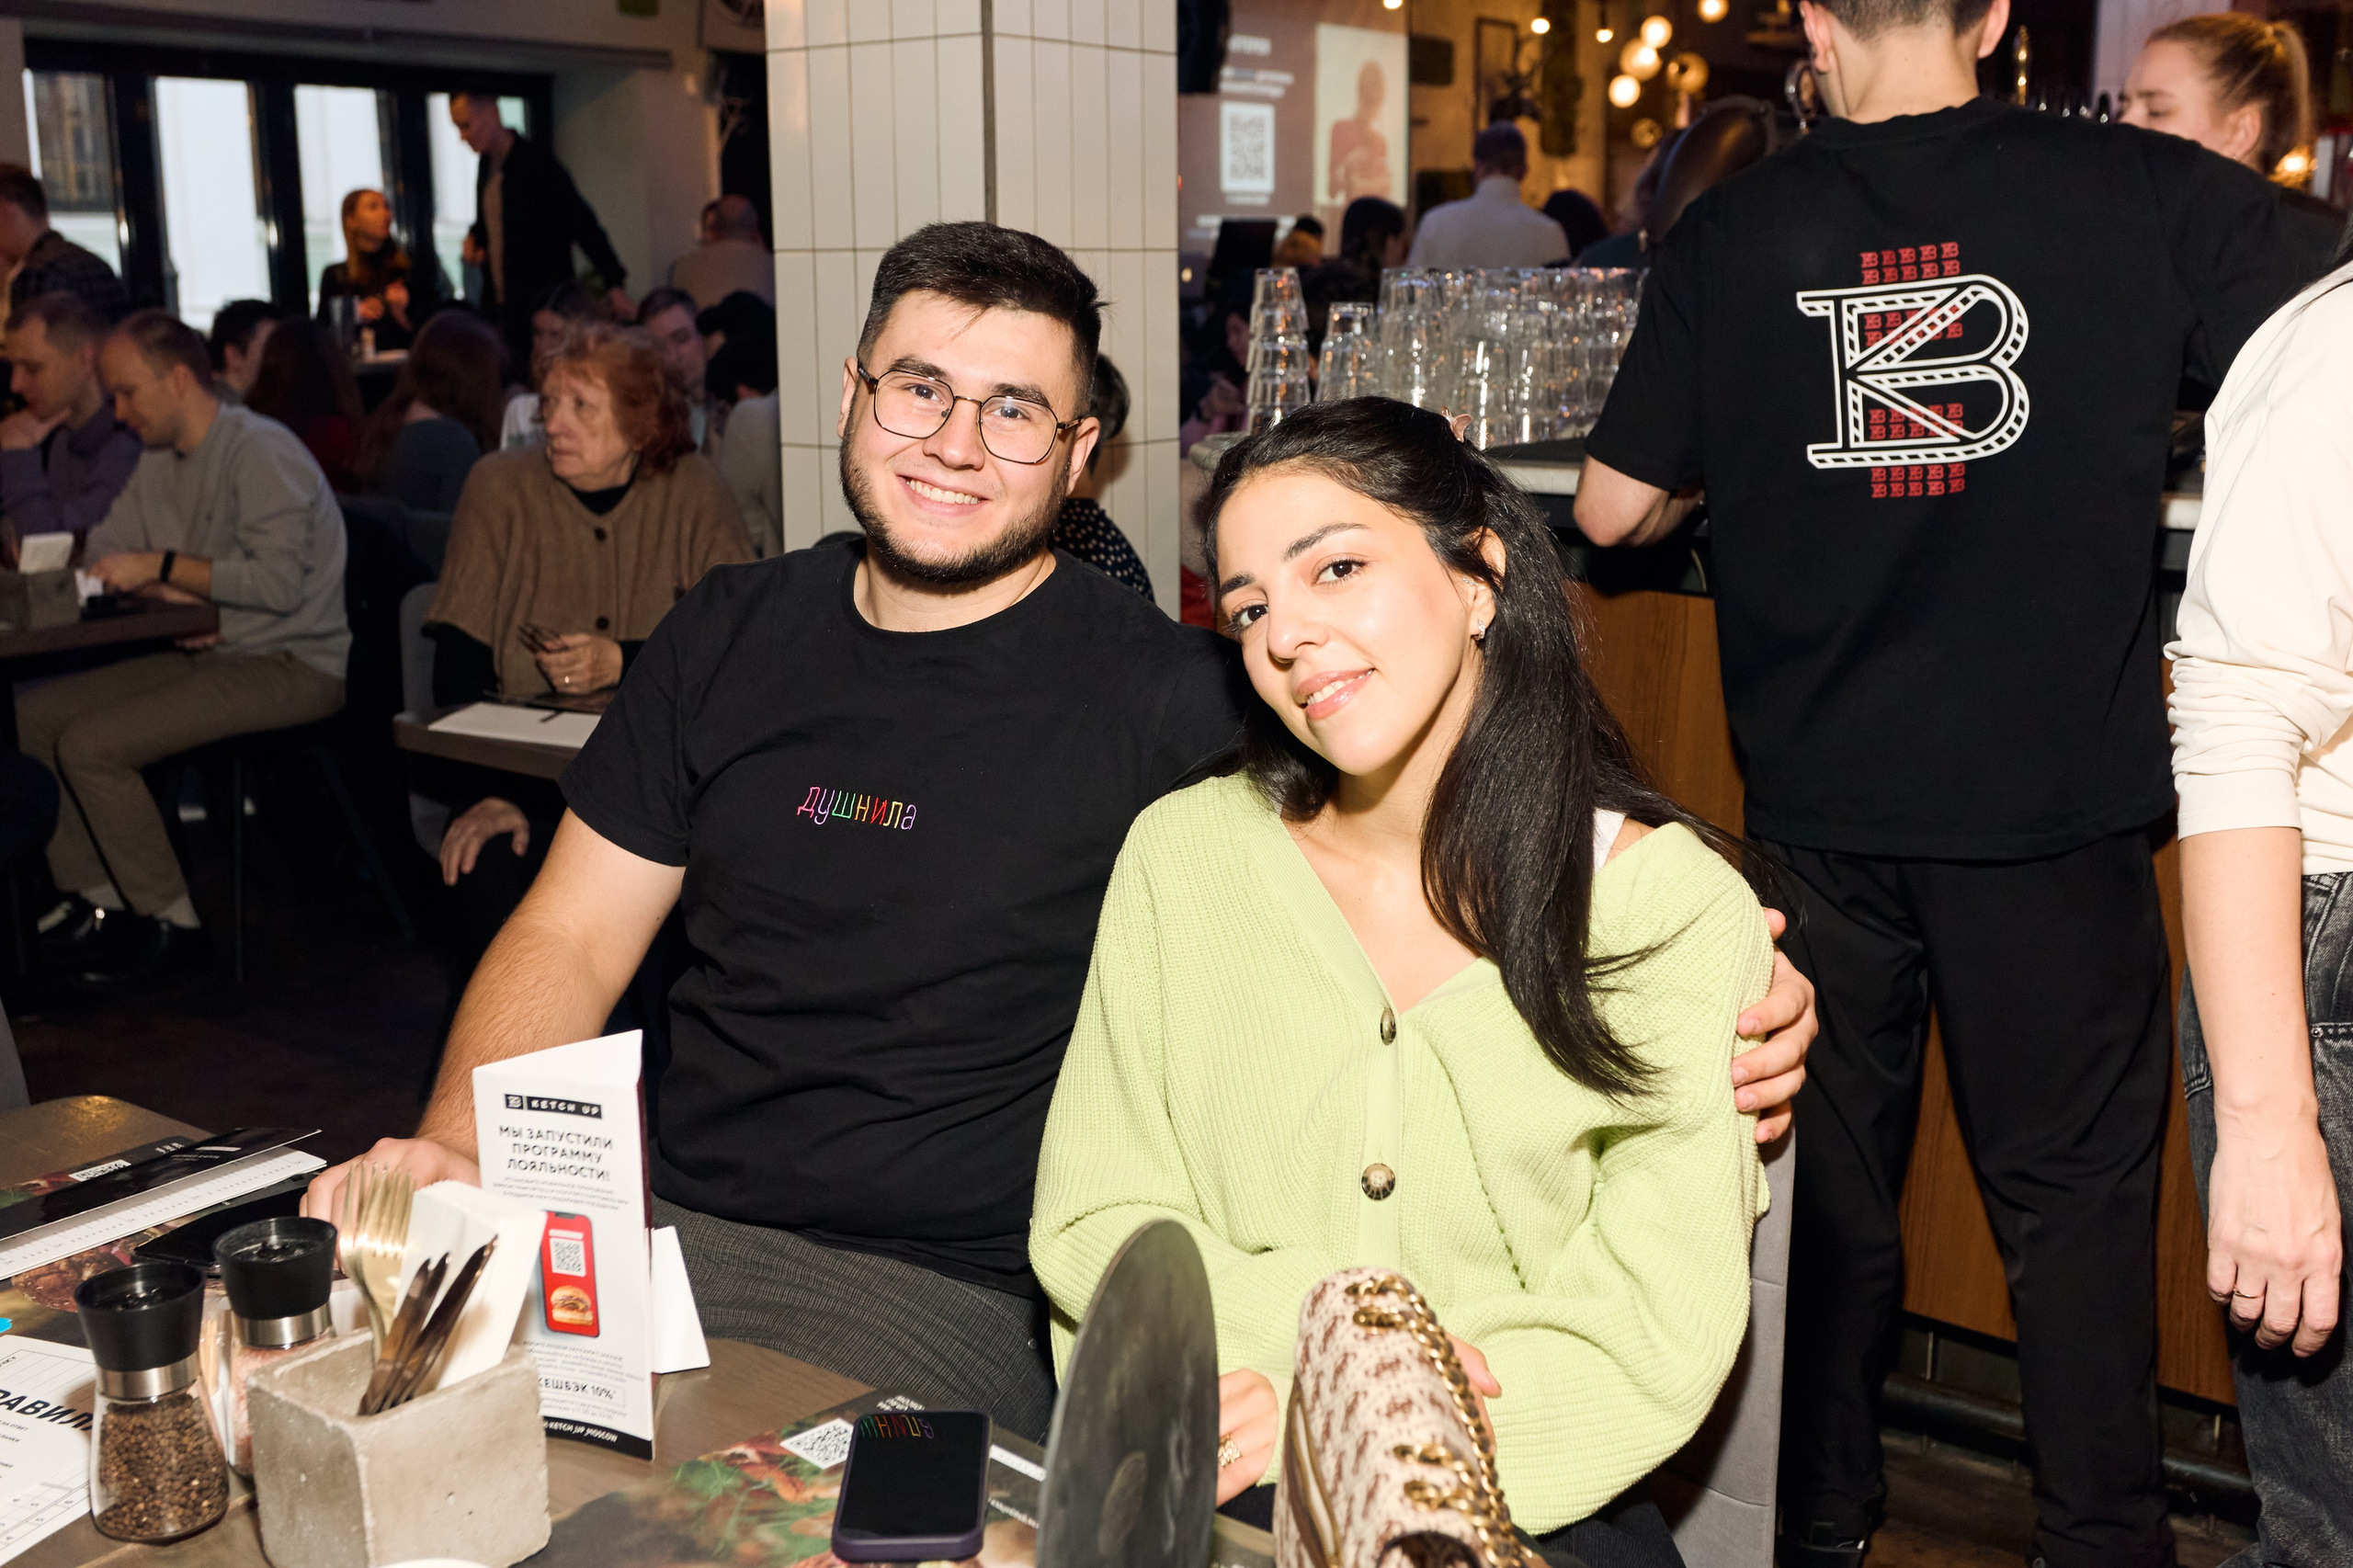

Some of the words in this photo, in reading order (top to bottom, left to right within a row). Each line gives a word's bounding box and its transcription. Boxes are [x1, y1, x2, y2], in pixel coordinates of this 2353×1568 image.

[797, 787, 916, 830] душнила
[531, 1100, 576, 1112] KETCH
[582, 1106, 599, 1115] UP
[499, 1126, 523, 1138] МЫ
[527, 1128, 613, 1150] ЗАПУСТИЛИ
[513, 1143, 602, 1164] ПРОГРАММУ
[507, 1159, 610, 1182] ЛОЯЛЬНОСТИ!
